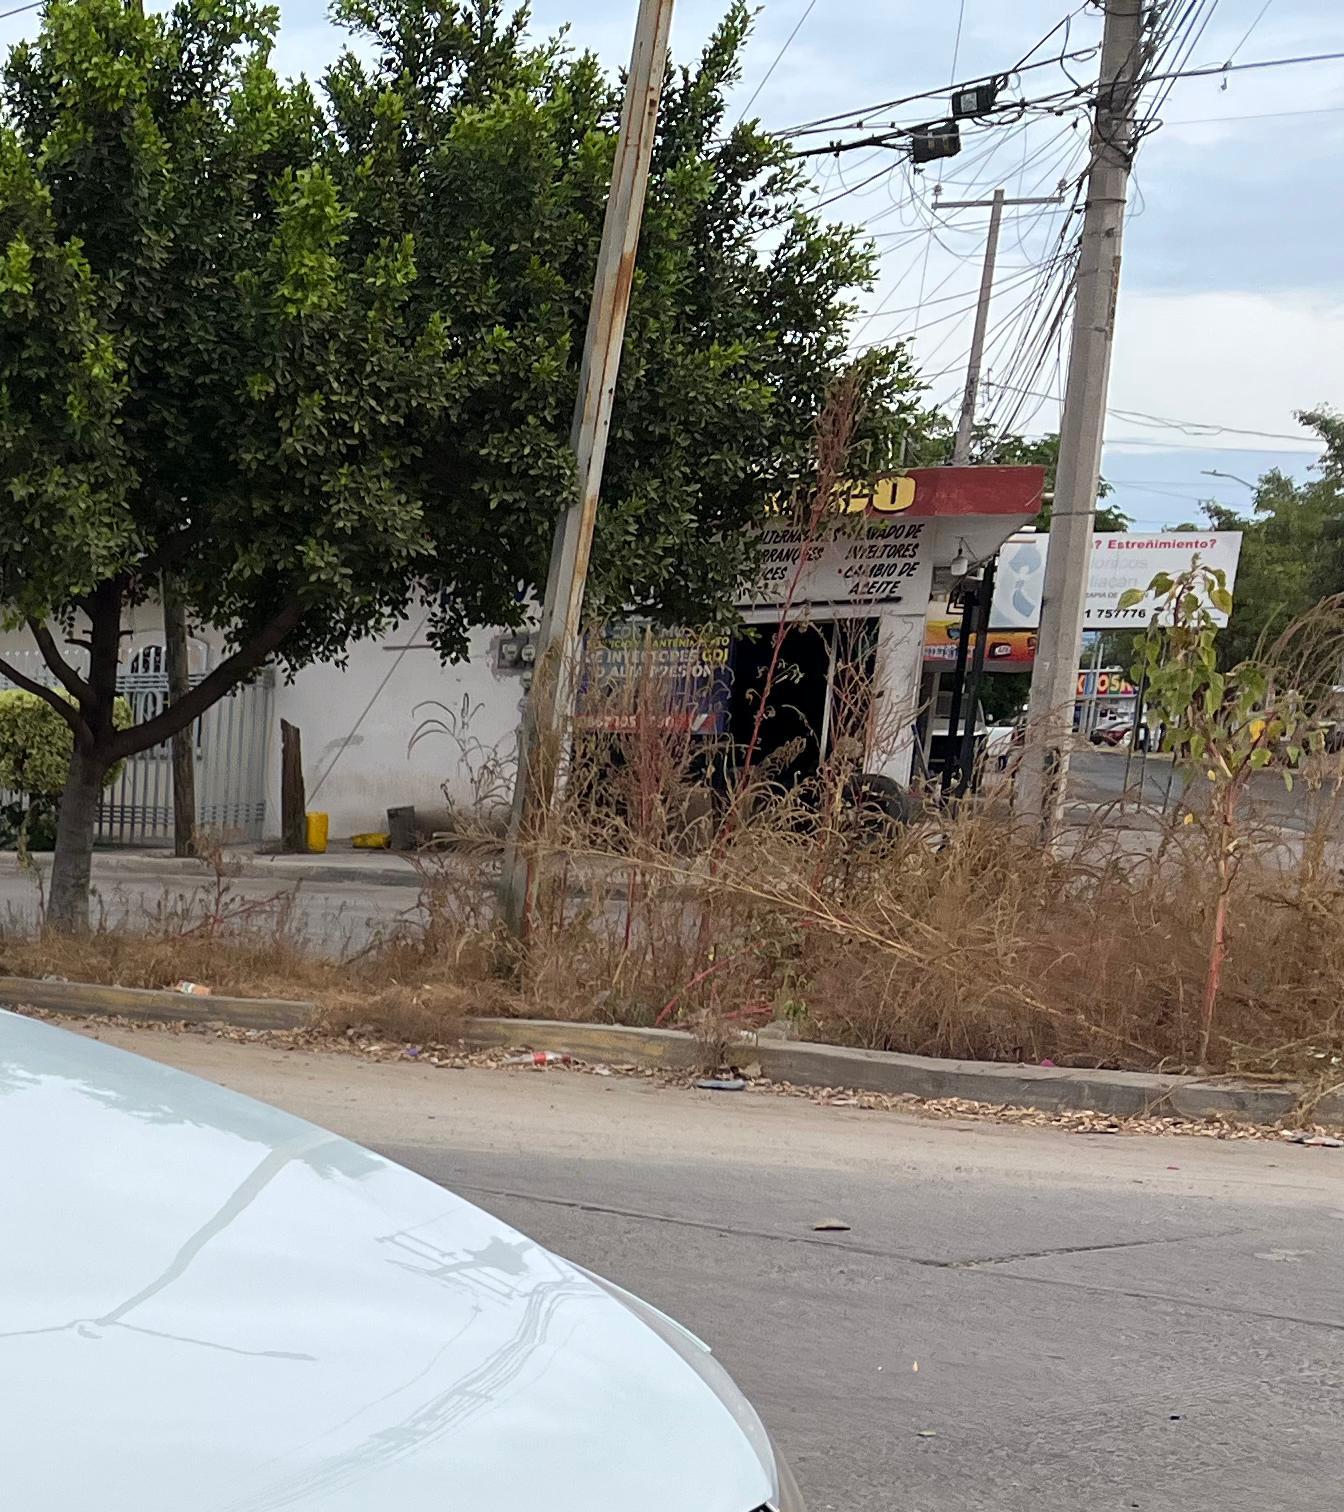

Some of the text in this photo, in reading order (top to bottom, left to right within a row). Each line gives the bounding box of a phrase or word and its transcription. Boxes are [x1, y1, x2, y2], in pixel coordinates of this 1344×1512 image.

[904, 523, 925, 539] DE
[1108, 538, 1217, 550] Estreñimiento?
[762, 547, 825, 565] RRANQES
[898, 561, 921, 578] DE
